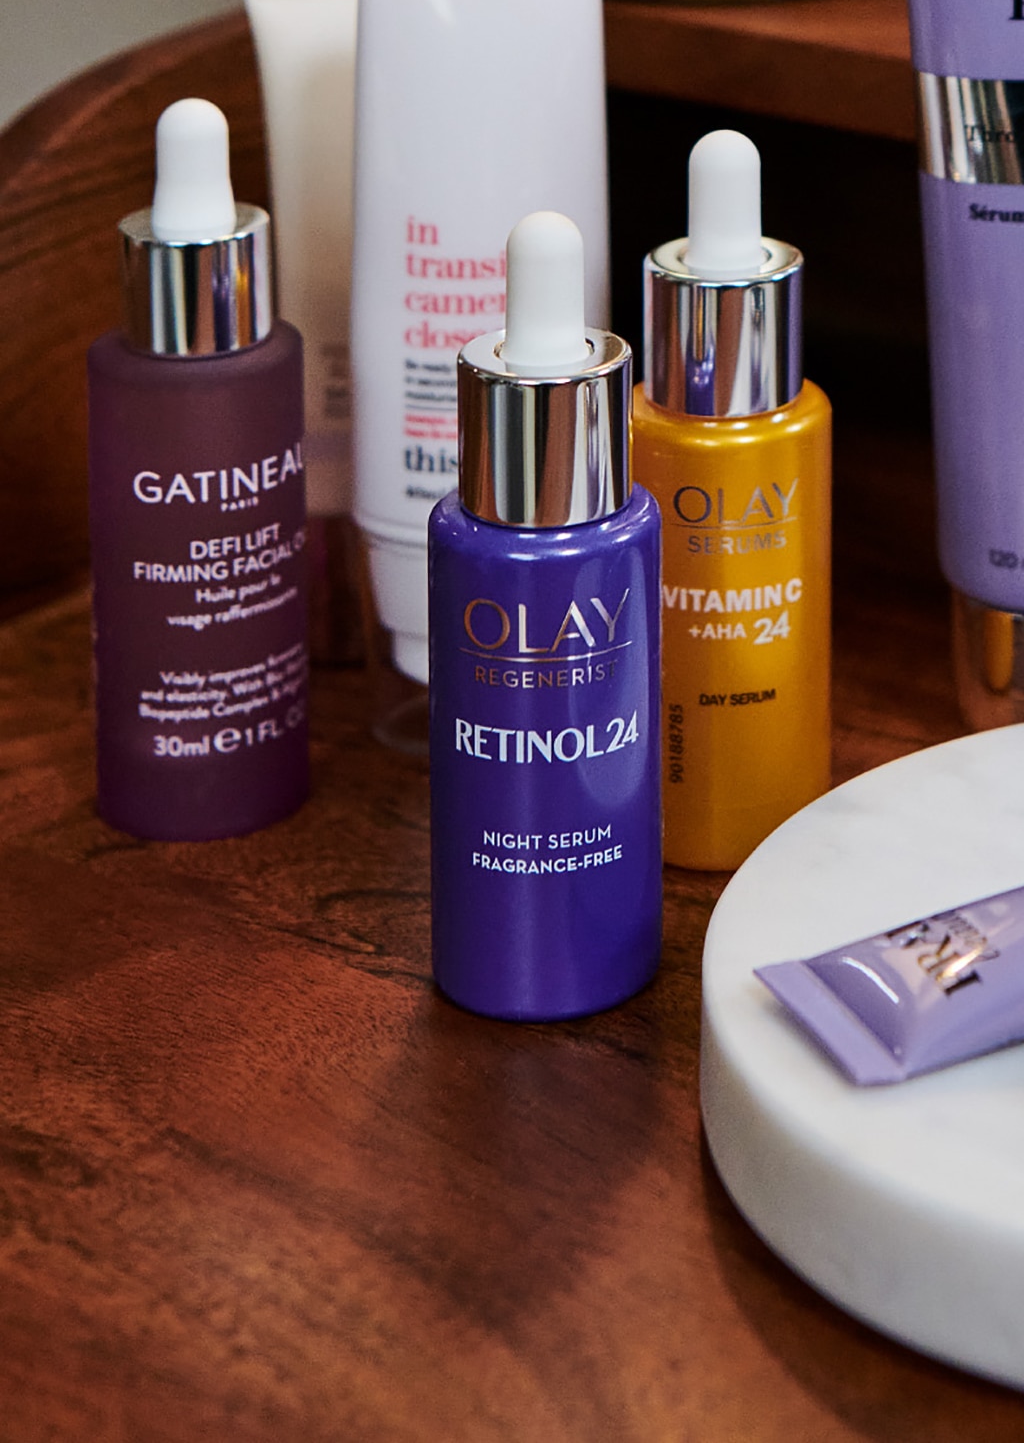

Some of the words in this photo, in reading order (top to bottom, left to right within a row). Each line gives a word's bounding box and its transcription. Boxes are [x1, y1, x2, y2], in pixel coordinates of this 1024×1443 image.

[405, 216, 439, 245] in
[673, 477, 799, 525] OLAY
[190, 534, 242, 561] DEFI
[246, 522, 281, 551] LIFT
[688, 530, 788, 556] SERUMS
[133, 560, 229, 584] FIRMING
[233, 541, 293, 577] FACIAL
[464, 588, 631, 654] OLAY
[688, 622, 747, 641] +AHA
[753, 610, 791, 646] 24
[475, 661, 618, 690] REGENERIST
[699, 693, 727, 707] DAY
[729, 689, 776, 706] SERUM
[153, 735, 210, 757] 30ml
[483, 830, 542, 851] NIGHT
[548, 824, 612, 851] SERUM
[473, 845, 623, 875] FRAGRANCE-FREE
